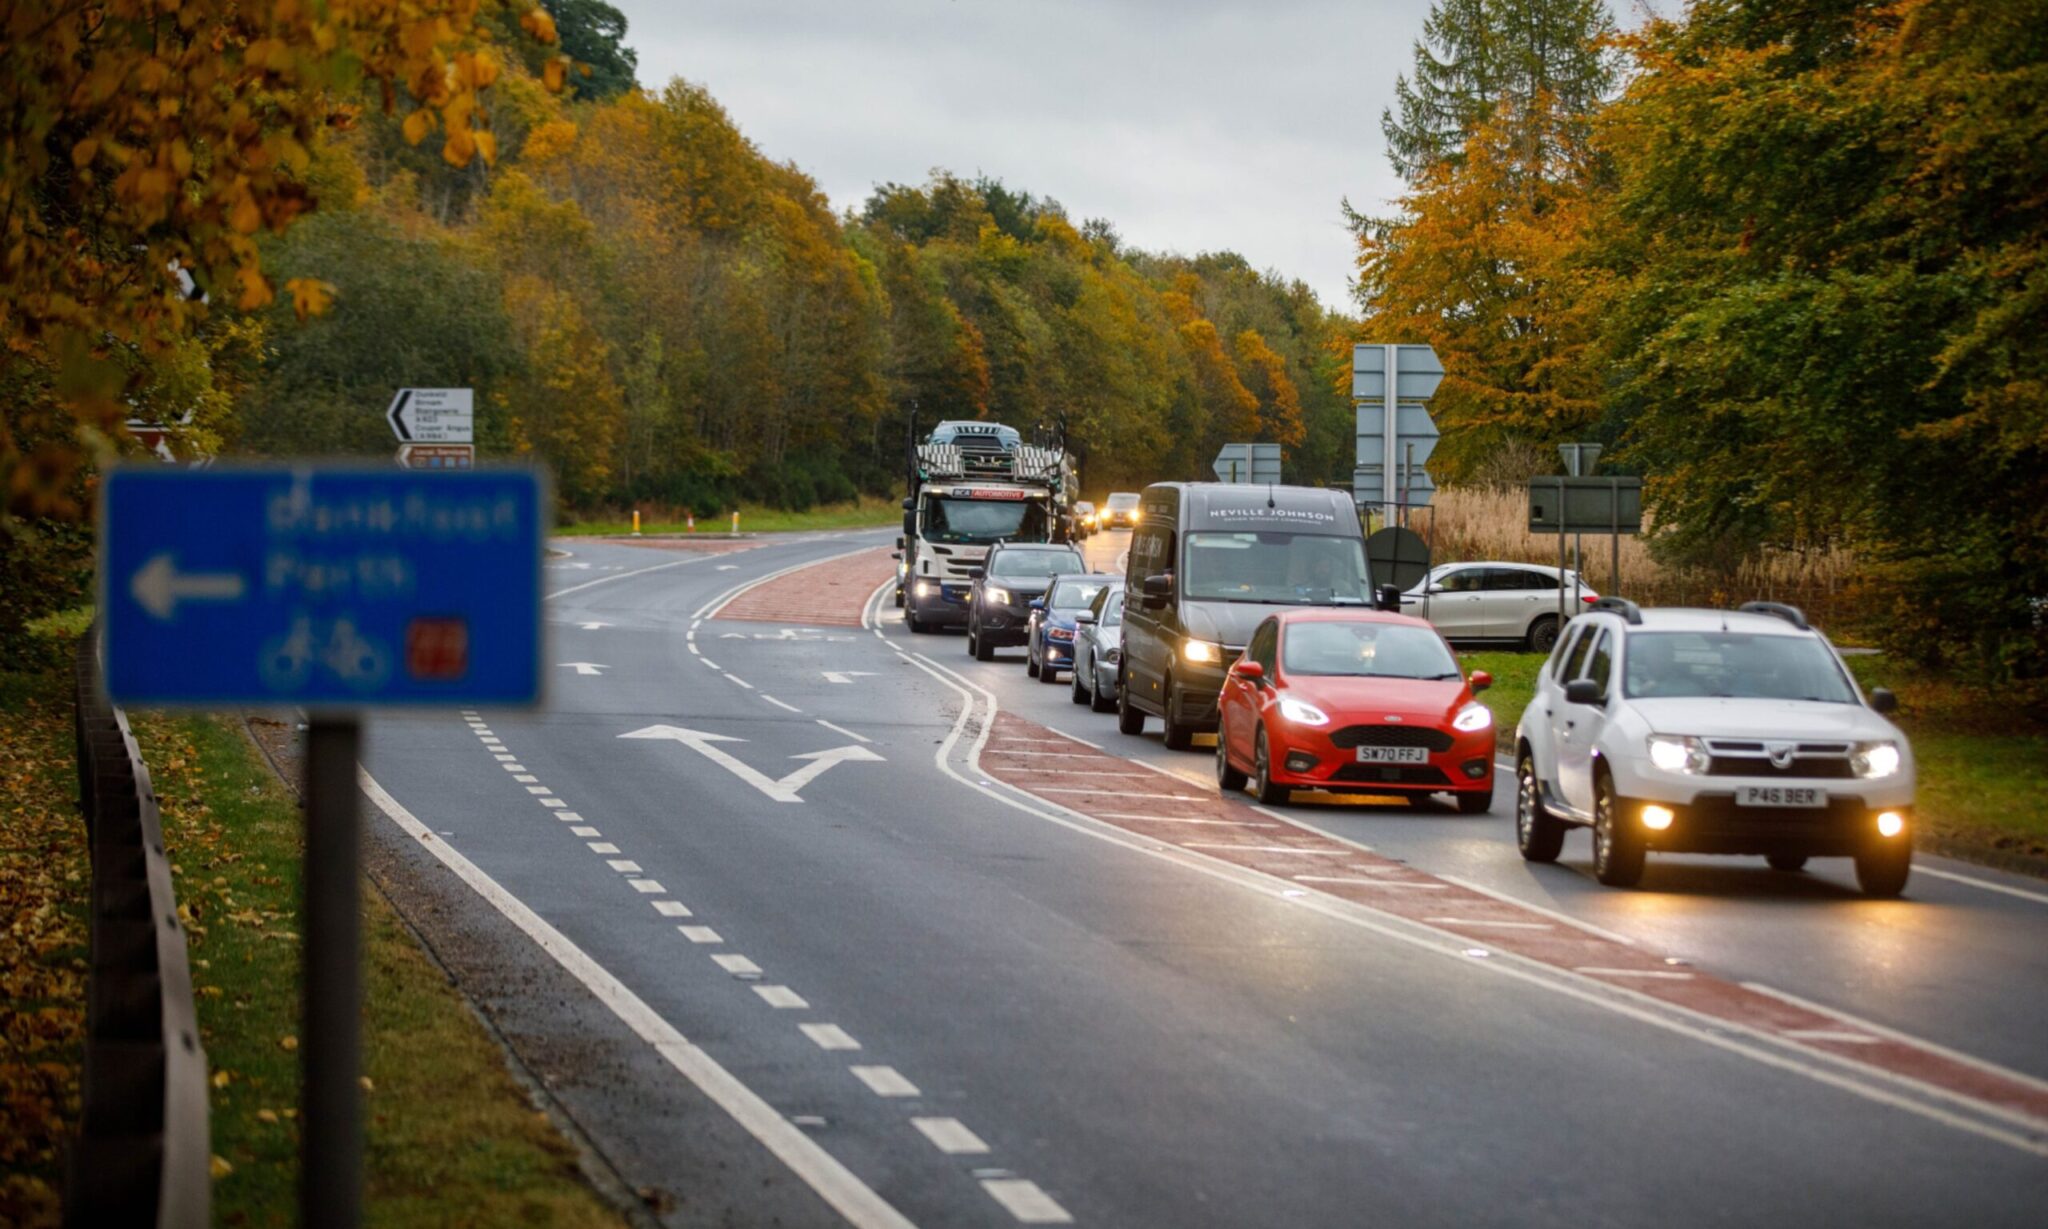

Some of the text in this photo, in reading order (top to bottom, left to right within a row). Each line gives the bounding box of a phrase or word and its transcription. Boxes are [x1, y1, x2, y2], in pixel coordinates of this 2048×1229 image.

[974, 490, 1022, 498] AUTOMOTIVE
[1209, 508, 1334, 521] NEVILLE JOHNSON
[1398, 748, 1423, 761] FFJ
